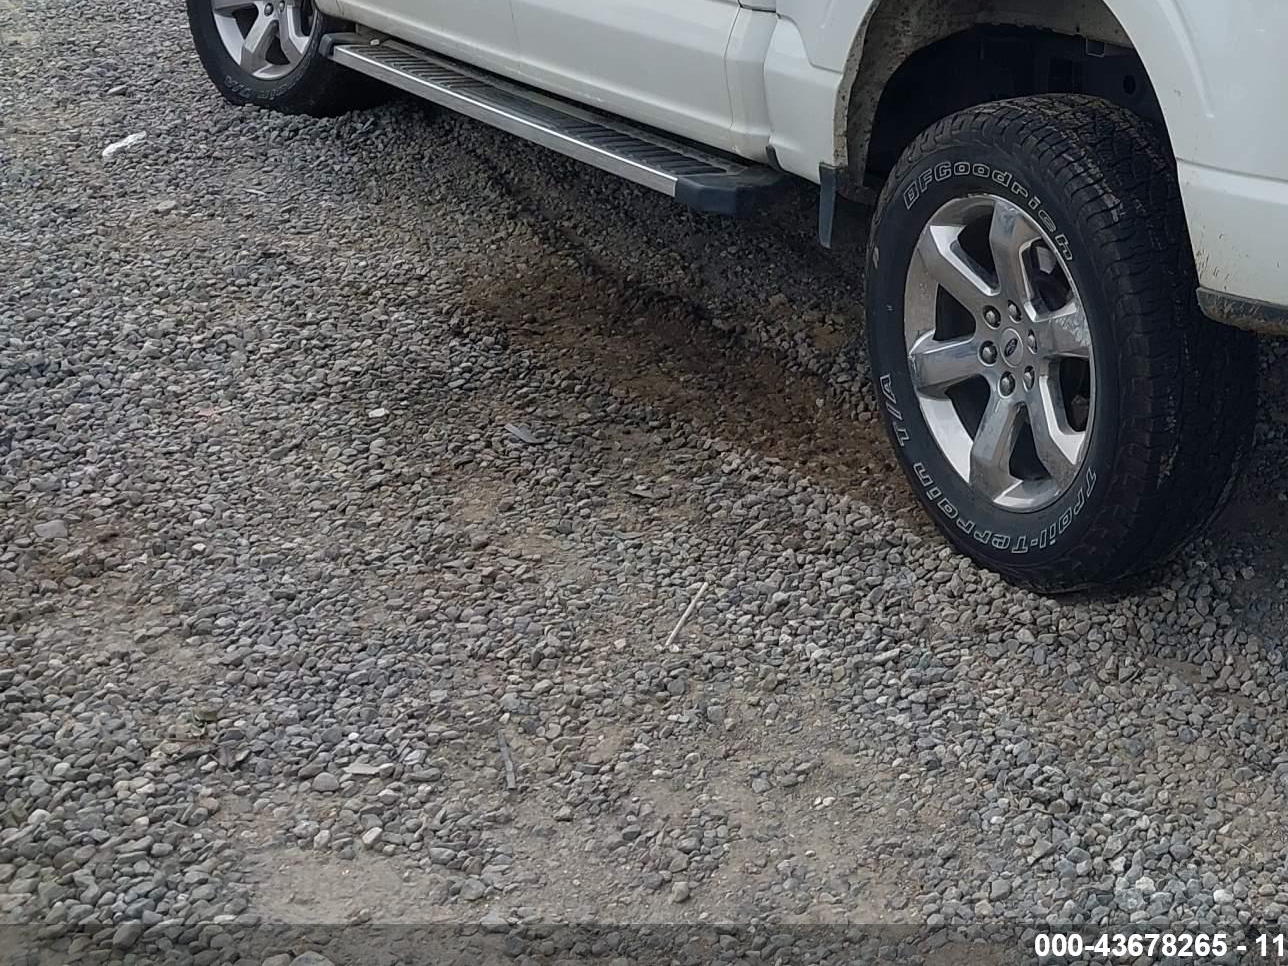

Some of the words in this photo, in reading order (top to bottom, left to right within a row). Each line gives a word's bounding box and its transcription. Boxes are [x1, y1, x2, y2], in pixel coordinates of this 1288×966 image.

[903, 161, 1073, 262] BFGoodrich
[879, 373, 911, 447] T/A
[912, 462, 1098, 554] Trail-Terrain
